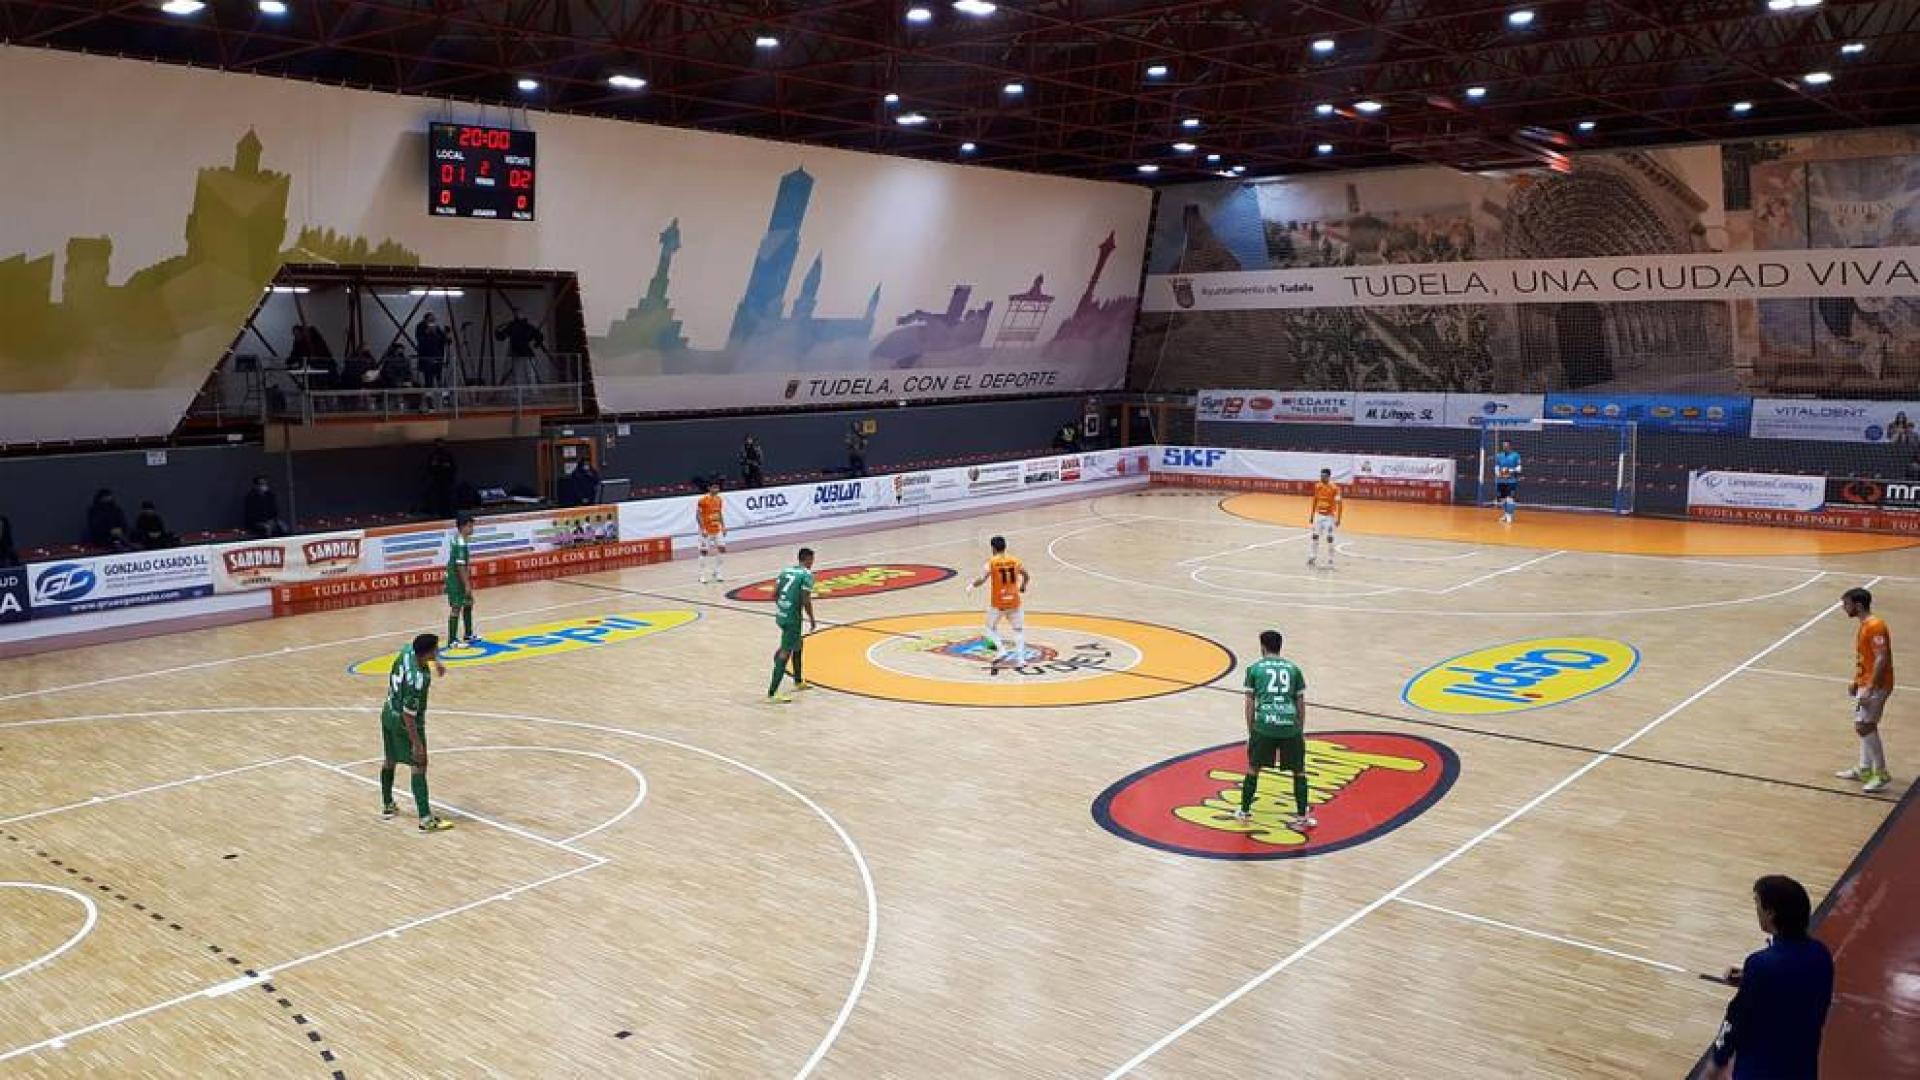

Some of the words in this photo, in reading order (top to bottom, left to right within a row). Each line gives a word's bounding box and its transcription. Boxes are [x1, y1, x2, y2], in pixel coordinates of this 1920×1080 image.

[460, 128, 510, 150] 20:00
[436, 149, 464, 161] LOCAL
[441, 164, 465, 184] 01
[510, 169, 532, 188] 02
[1280, 283, 1314, 294] Tudela
[1343, 272, 1499, 298] TUDELA,
[1511, 268, 1599, 295] UNA
[1611, 261, 1790, 291] CIUDAD
[1805, 259, 1919, 286] VIVA
[808, 377, 894, 397] TUDELA,
[903, 374, 950, 393] CON
[952, 373, 973, 390] EL
[979, 370, 1058, 390] DEPORTE
[1775, 406, 1866, 418] VITALDENT
[1163, 448, 1226, 468] SKF
[1697, 507, 1743, 520] TUDELA
[1746, 511, 1772, 522] CON
[1775, 513, 1789, 522] EL
[1793, 514, 1850, 527] DEPORTE
[229, 548, 282, 570] SANDUA
[308, 541, 358, 561] SANDUA
[514, 553, 560, 570] TUDELA
[562, 550, 585, 563] CON
[588, 548, 602, 560] EL
[604, 543, 650, 558] DEPORTE
[104, 560, 152, 577] GONZALO
[152, 555, 193, 571] CASADO
[998, 567, 1017, 585] 11
[312, 580, 368, 598] TUDELA
[371, 576, 400, 589] CON
[404, 573, 418, 586] EL
[783, 573, 796, 592] 7
[1266, 668, 1291, 694] 29
[1443, 648, 1609, 704] aspil
